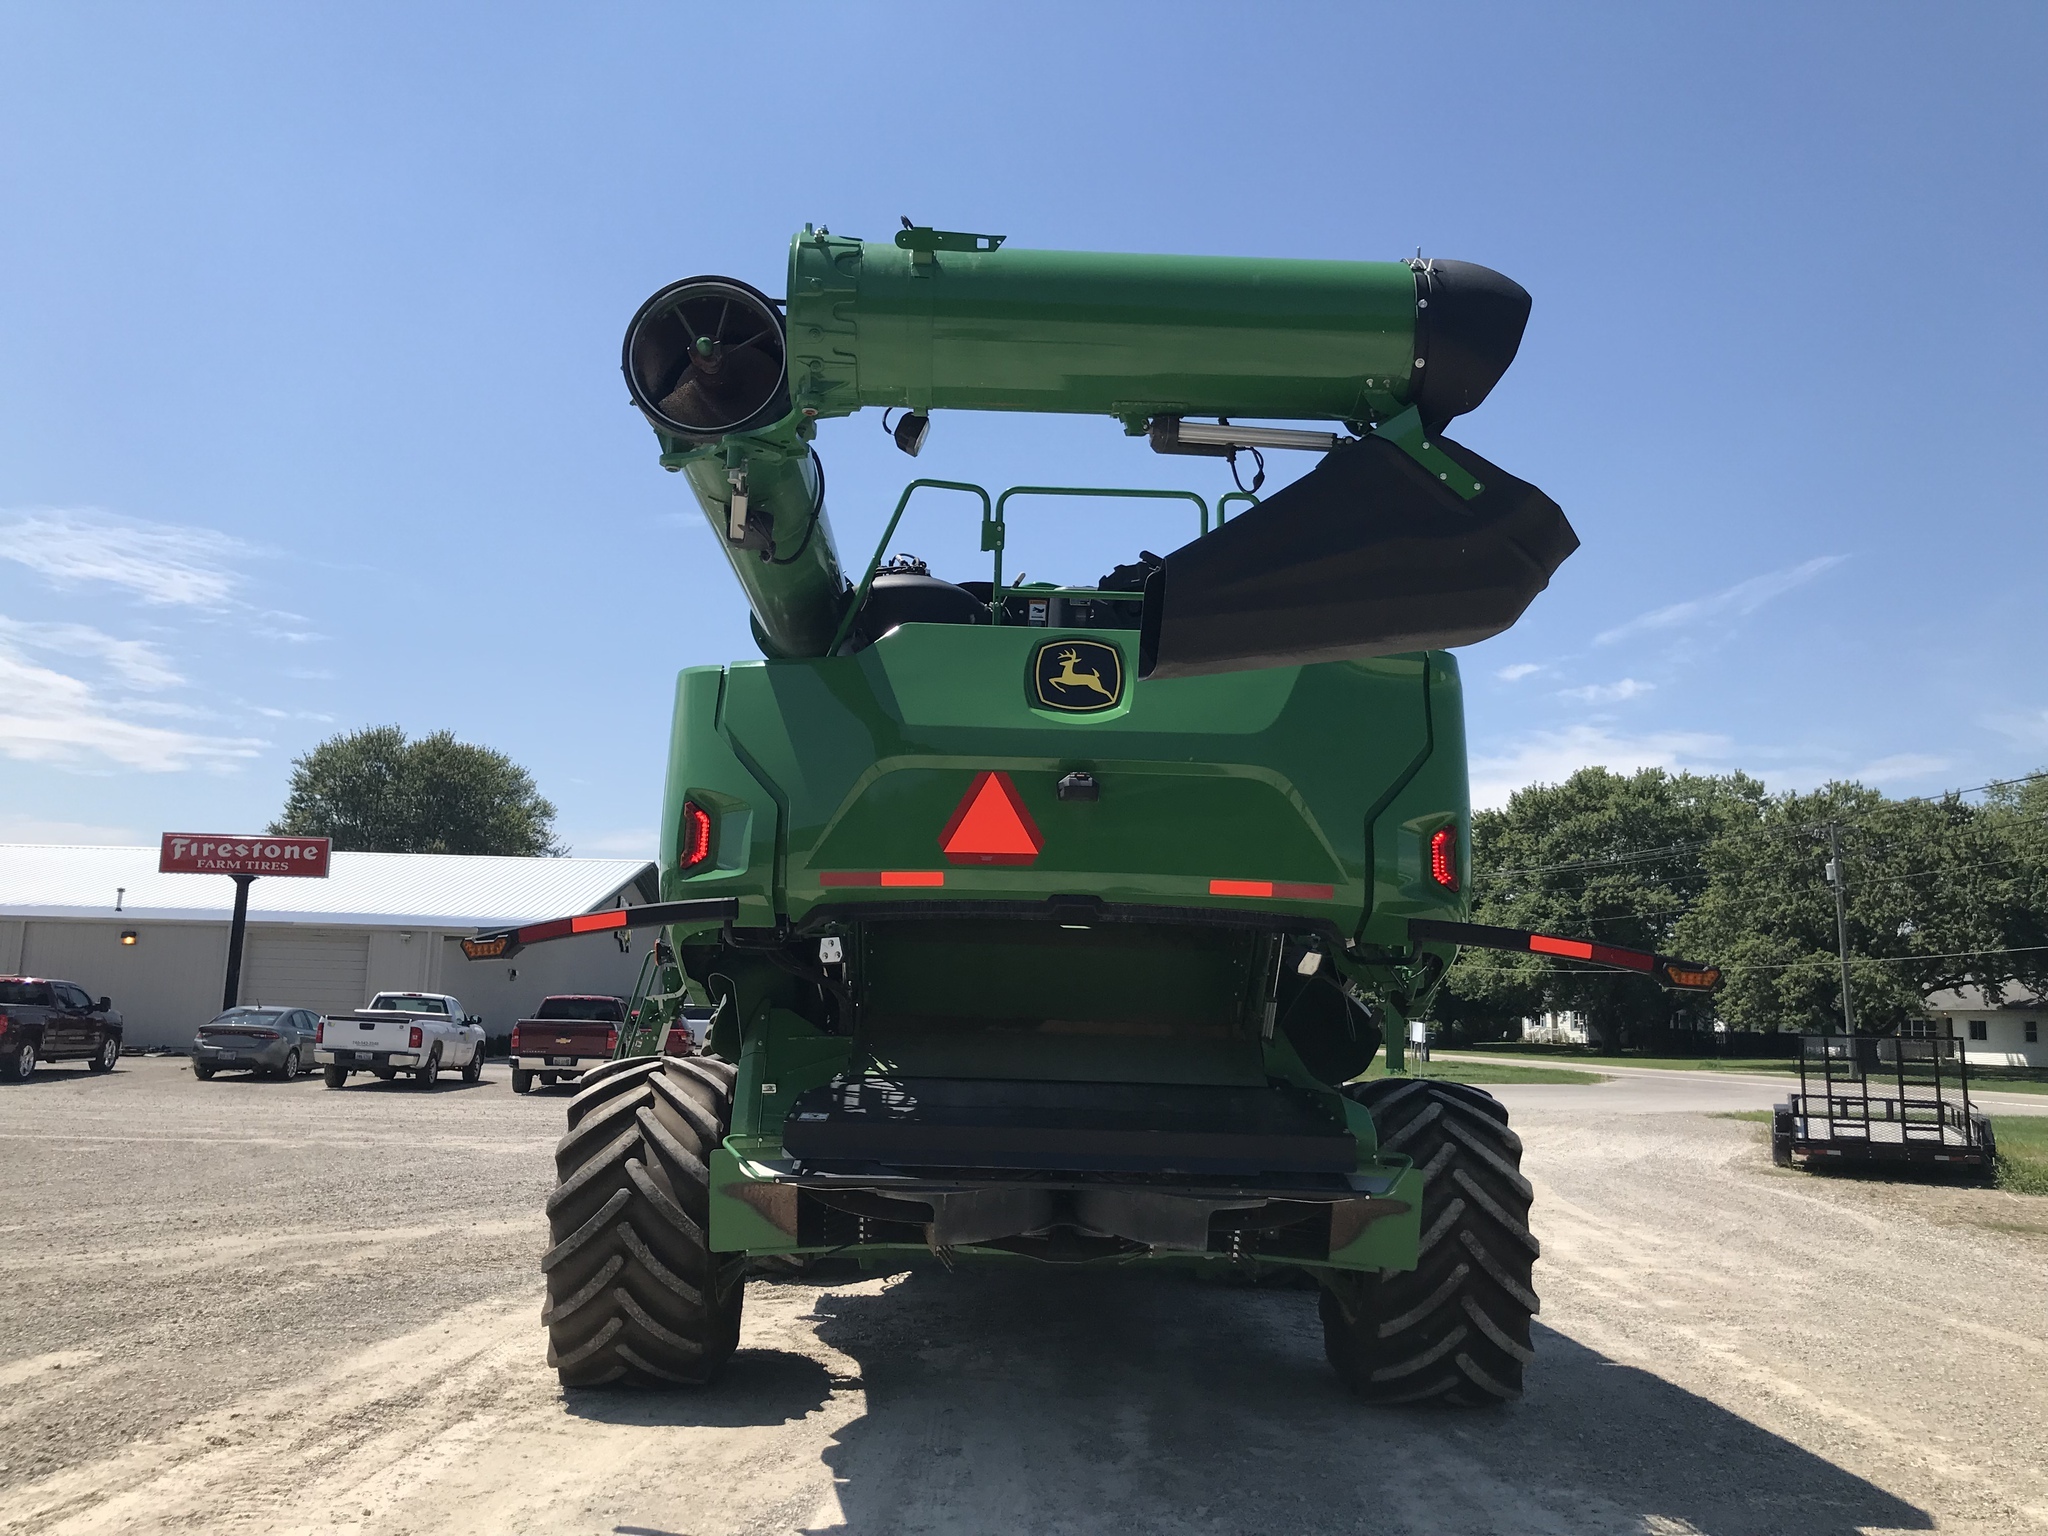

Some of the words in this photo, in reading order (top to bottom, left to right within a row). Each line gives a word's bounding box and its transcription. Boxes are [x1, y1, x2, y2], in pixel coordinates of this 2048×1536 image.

[170, 838, 319, 860] Firestone
[196, 859, 241, 869] FARM
[245, 861, 289, 871] TIRES
